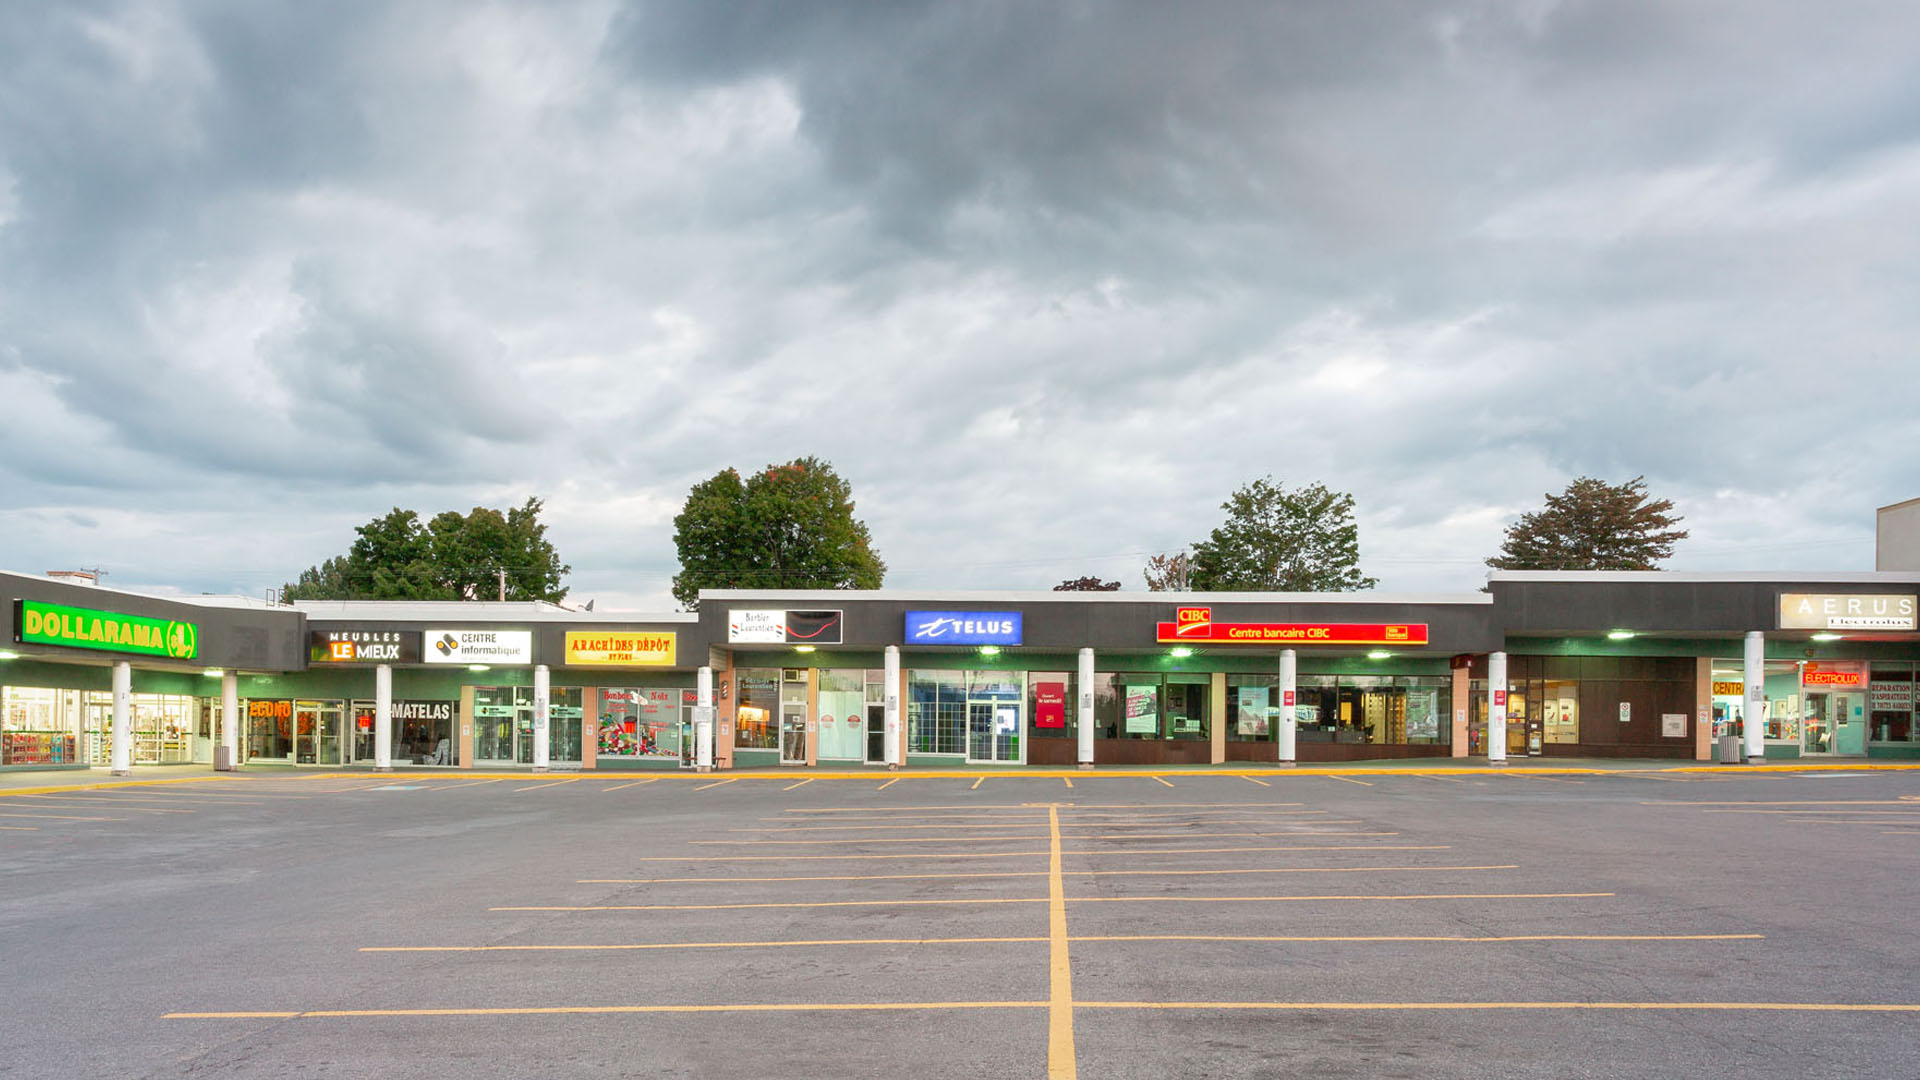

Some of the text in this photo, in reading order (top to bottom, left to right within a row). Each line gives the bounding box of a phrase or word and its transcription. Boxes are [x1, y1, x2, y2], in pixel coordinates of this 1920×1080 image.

[1798, 599, 1912, 615] AERUS
[746, 612, 769, 622] Barbier
[1180, 610, 1208, 621] CIBC
[26, 610, 163, 648] DOLLARAMA
[952, 621, 1013, 634] TELUS
[1229, 628, 1330, 638] Centre bancaire CIBC
[330, 632, 400, 642] MEUBLES
[462, 633, 496, 643] CENTRE
[637, 637, 670, 651] DÉPÔT
[333, 644, 399, 659] LE MIEUX
[461, 645, 521, 656] informatique
[1805, 674, 1860, 684] ELECTROLUX
[249, 701, 291, 717] ECONO
[391, 703, 449, 719] MATELAS
